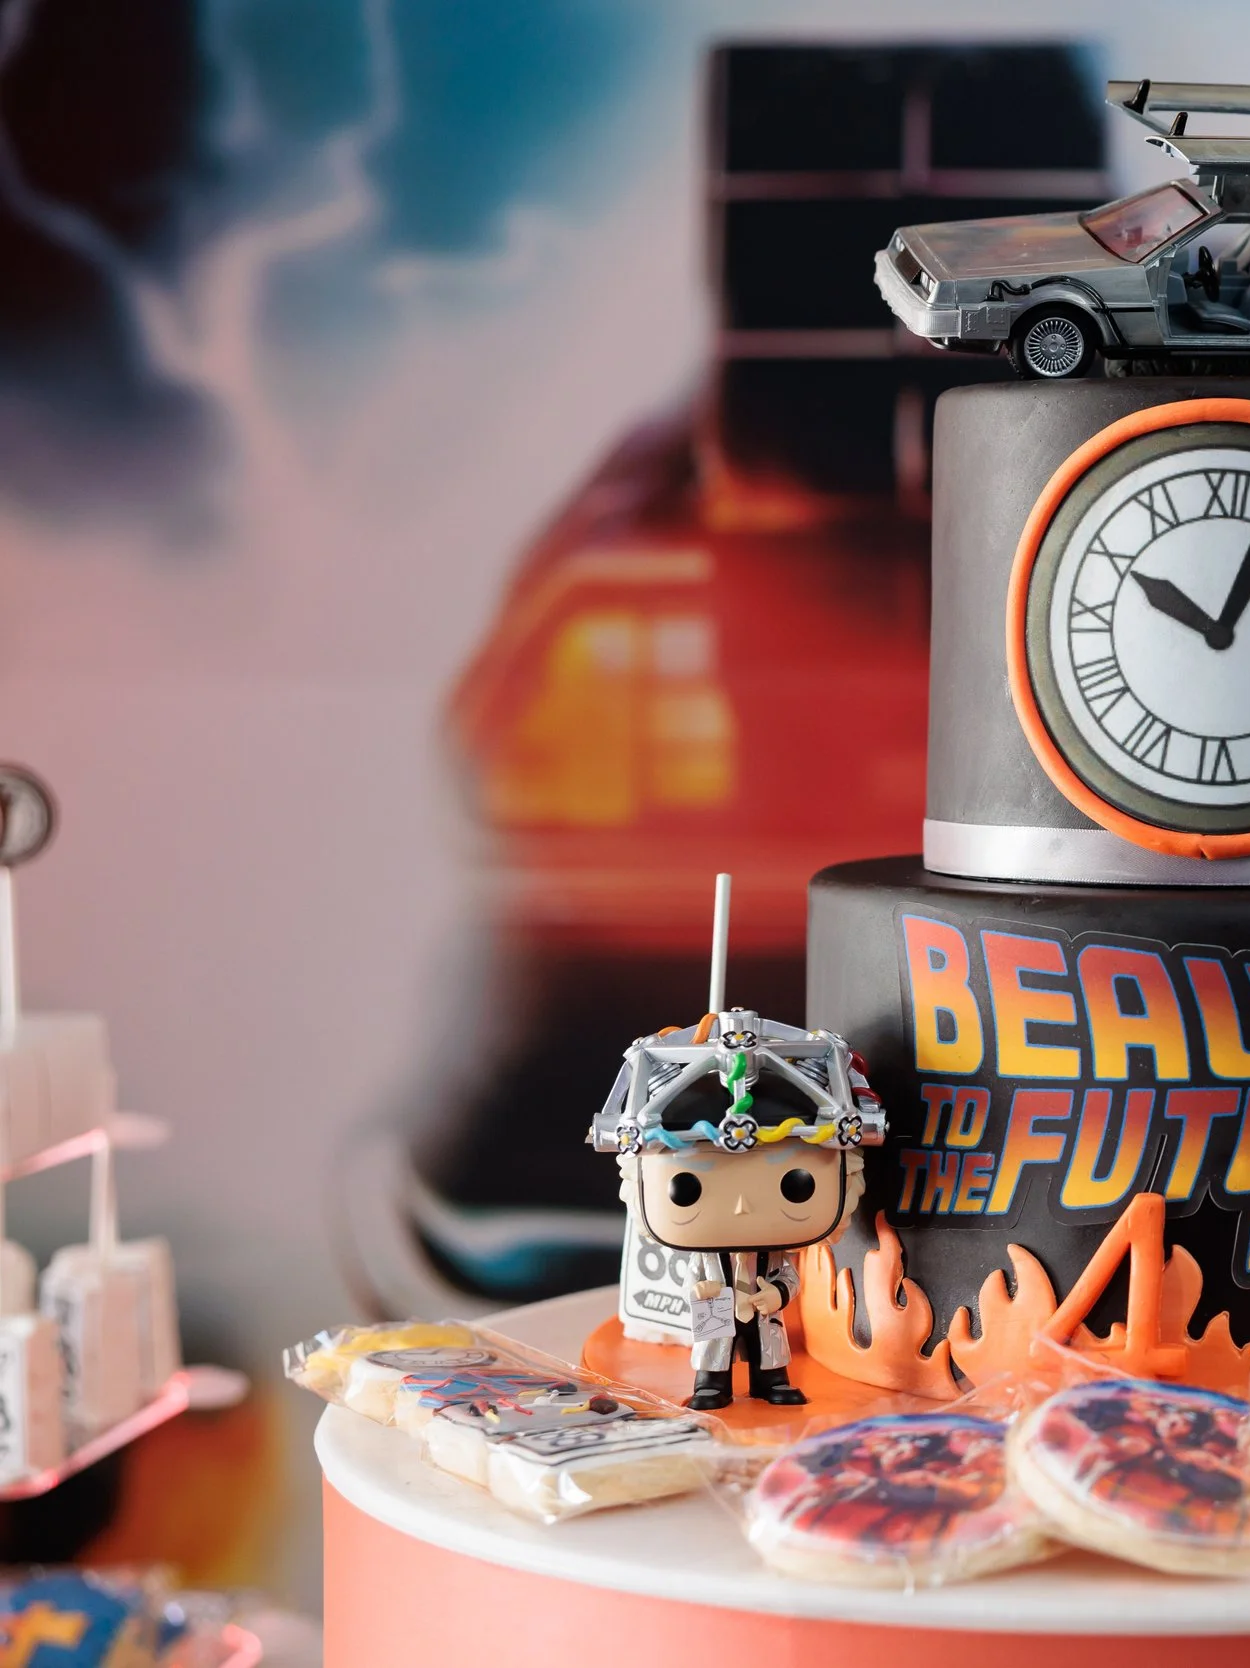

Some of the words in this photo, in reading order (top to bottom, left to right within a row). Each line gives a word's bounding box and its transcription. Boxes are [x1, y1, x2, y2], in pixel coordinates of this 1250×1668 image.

[1132, 481, 1181, 539] XI
[1201, 471, 1250, 519] XII
[1087, 532, 1137, 580] X
[1069, 595, 1114, 634] IX
[1074, 656, 1130, 722] VIII
[1121, 711, 1173, 773] VII
[1197, 737, 1237, 783] VI
[920, 1083, 991, 1148] TO
[896, 1150, 995, 1215] THE
[642, 1290, 685, 1316] MPH
